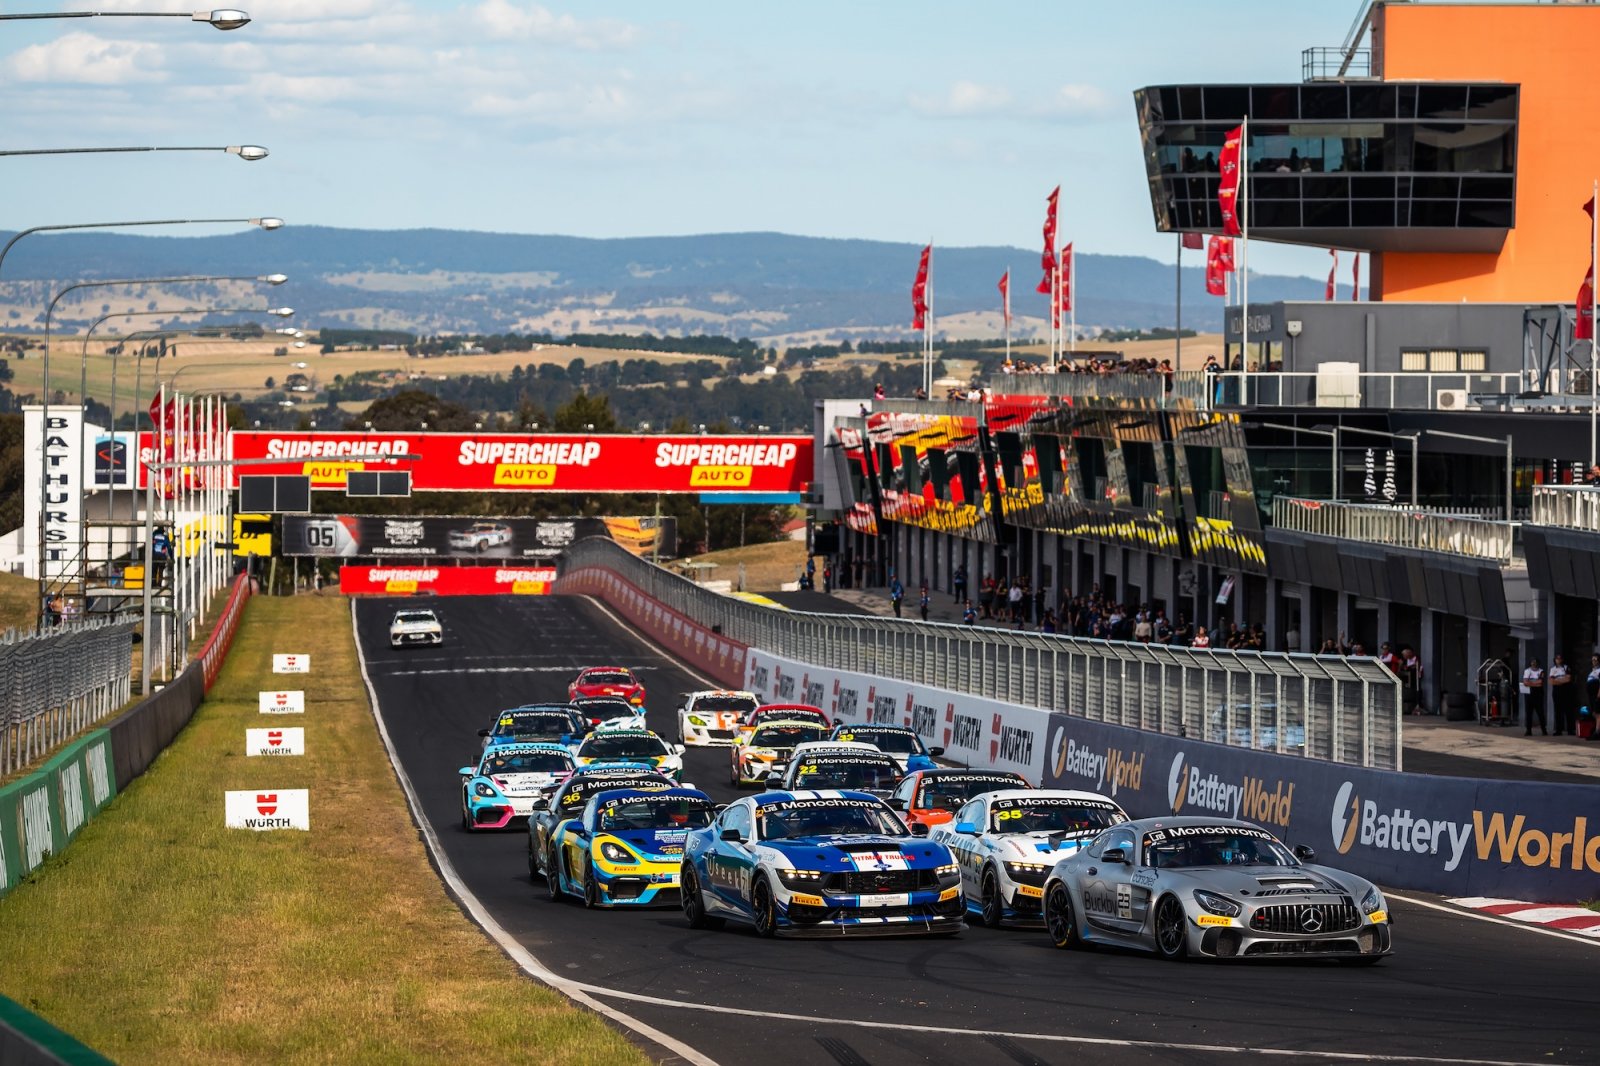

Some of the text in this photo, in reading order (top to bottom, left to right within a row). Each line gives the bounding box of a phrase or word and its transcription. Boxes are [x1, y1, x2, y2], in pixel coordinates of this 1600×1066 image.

[266, 439, 409, 464] SUPERCHEAP
[458, 440, 601, 466] SUPERCHEAP
[656, 442, 797, 468] SUPERCHEAP
[311, 467, 355, 478] AUT
[501, 469, 549, 481] AUTO
[697, 470, 745, 482] AUTO
[47, 418, 68, 560] BATHURST
[307, 527, 333, 546] 05
[369, 569, 439, 582] SUPERCHEAP
[495, 570, 557, 583] SUPERCHEA
[513, 711, 570, 719] Monochrome
[912, 703, 938, 739] WÜRTH
[850, 727, 916, 736] Monochrome
[952, 714, 982, 751] WÜRTH
[260, 747, 292, 755] WÜRTH
[1000, 724, 1034, 766] WÜRTH
[498, 747, 571, 759] Monochrome
[817, 758, 891, 766] Monochrome
[800, 765, 817, 775] 22
[588, 779, 673, 789] Monochrome
[937, 775, 1026, 786] Monochrome
[562, 792, 581, 805] 36
[622, 794, 703, 805] Monochrome
[782, 799, 884, 810] Monochrome
[1017, 799, 1115, 811] Monochrome
[606, 808, 615, 817] 1
[999, 809, 1023, 820] 35
[245, 818, 291, 828] WÜRTH
[1168, 825, 1272, 841] Monochrome
[795, 896, 821, 904] PIRELLI
[1200, 916, 1232, 926] PIRELLI
